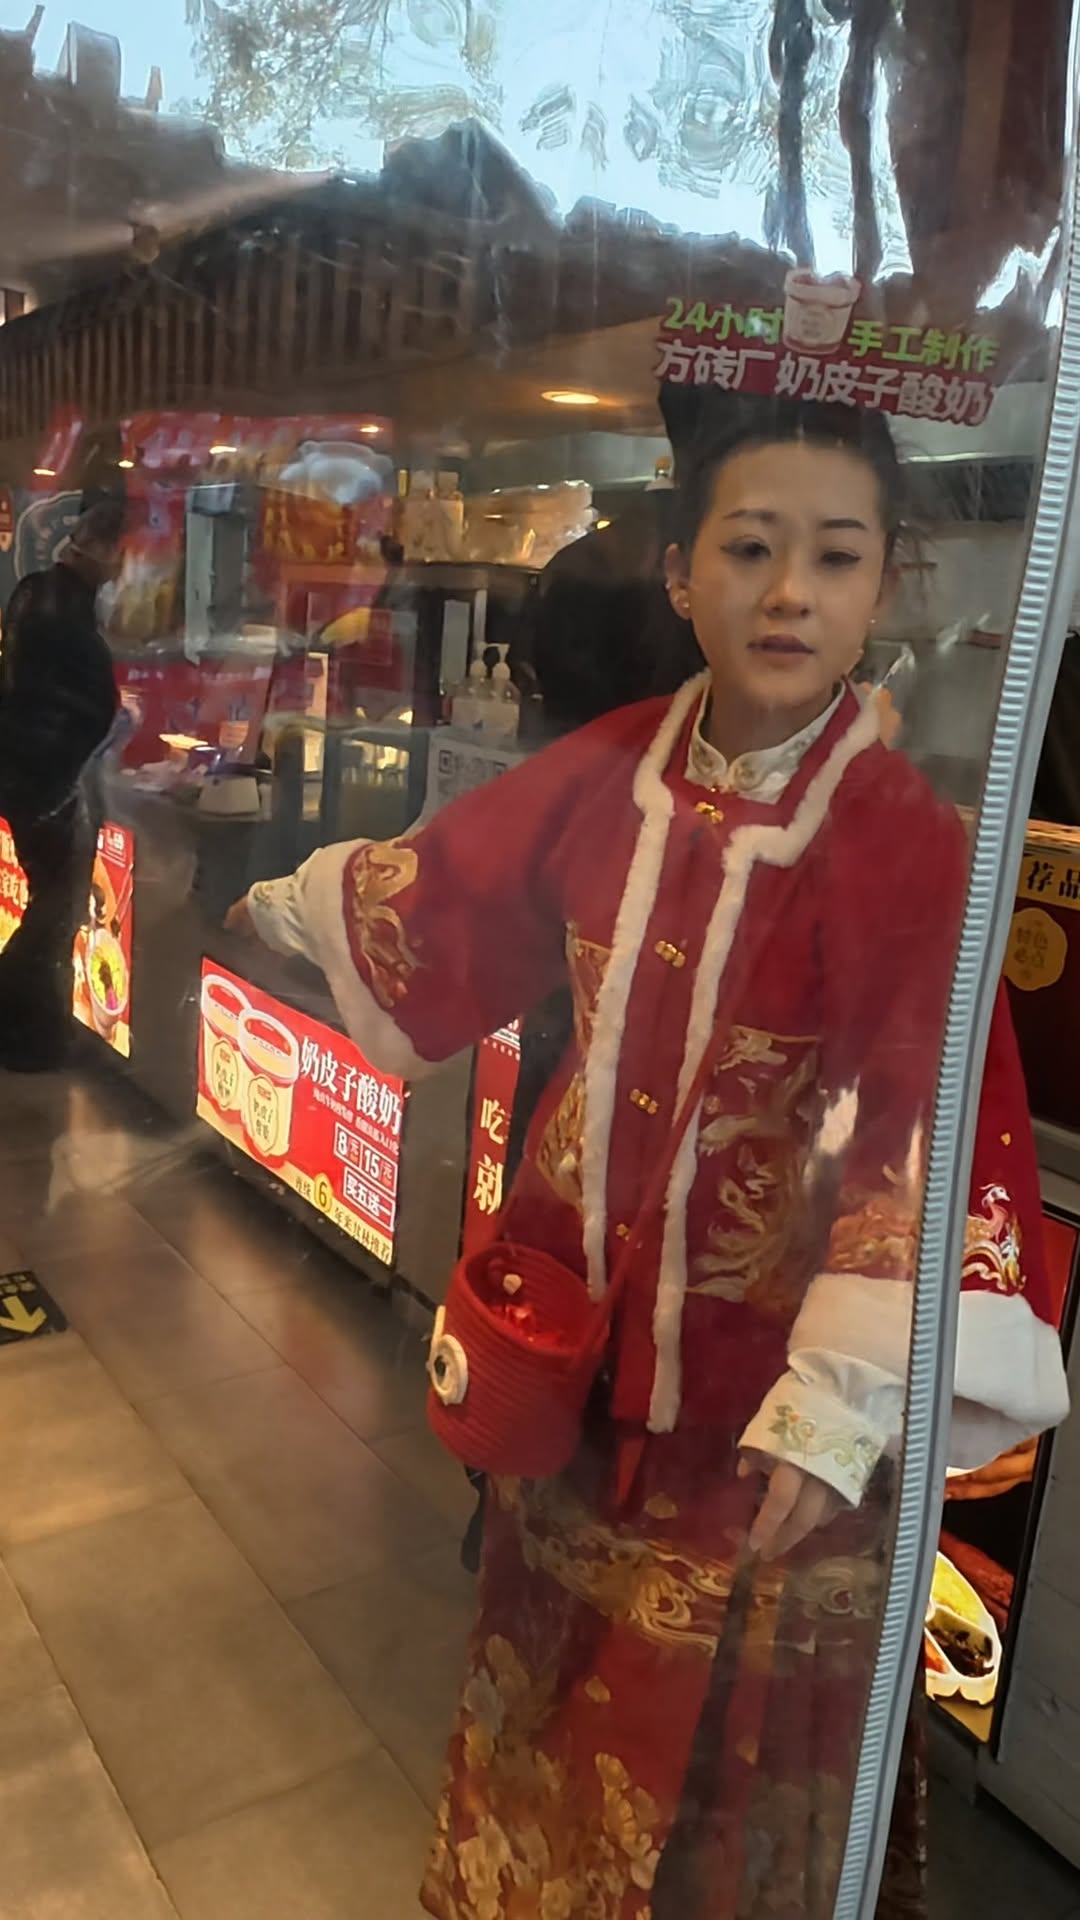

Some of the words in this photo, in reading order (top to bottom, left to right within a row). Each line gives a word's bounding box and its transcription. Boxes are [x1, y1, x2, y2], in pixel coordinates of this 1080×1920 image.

[663, 297, 785, 345] 24小时
[848, 319, 998, 373] 手工制作
[654, 338, 776, 391] 方砖厂
[774, 352, 996, 425] 奶皮子酸奶
[301, 1036, 402, 1136] 奶皮子酸奶
[347, 1175, 391, 1217] 买五送一
